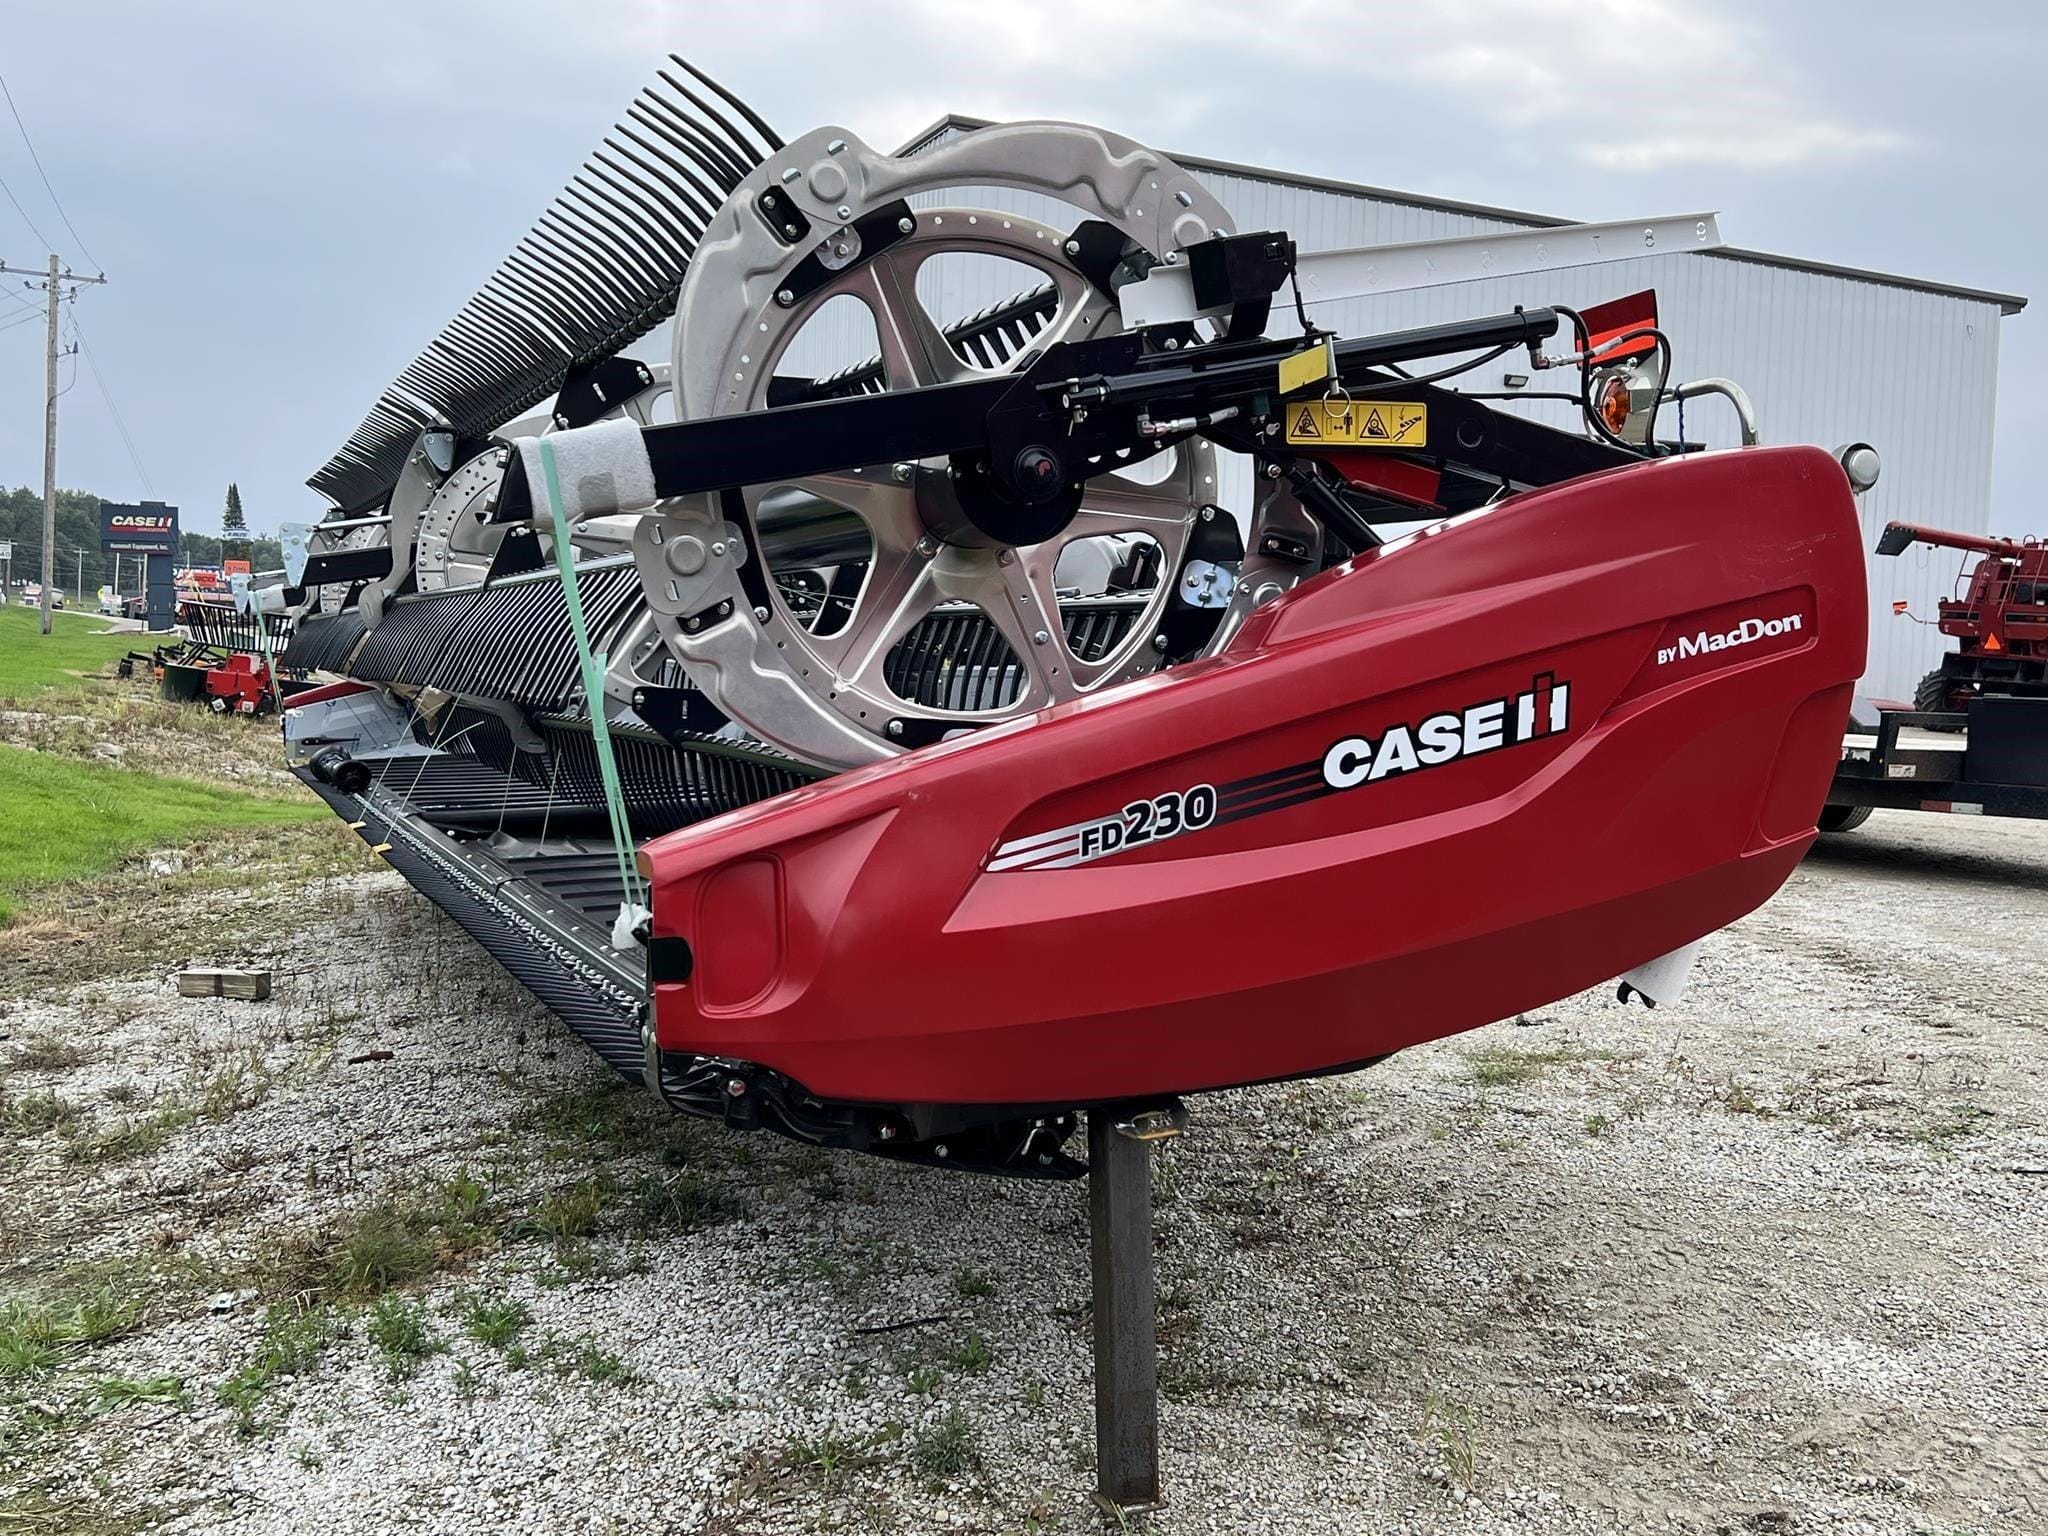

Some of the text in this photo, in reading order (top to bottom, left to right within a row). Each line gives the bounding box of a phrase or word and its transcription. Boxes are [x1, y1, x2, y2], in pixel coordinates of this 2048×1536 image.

[111, 515, 157, 527] CASE
[1657, 614, 1802, 665] BY MacDon
[1323, 700, 1505, 789] CASE
[1079, 784, 1217, 860] FD230
